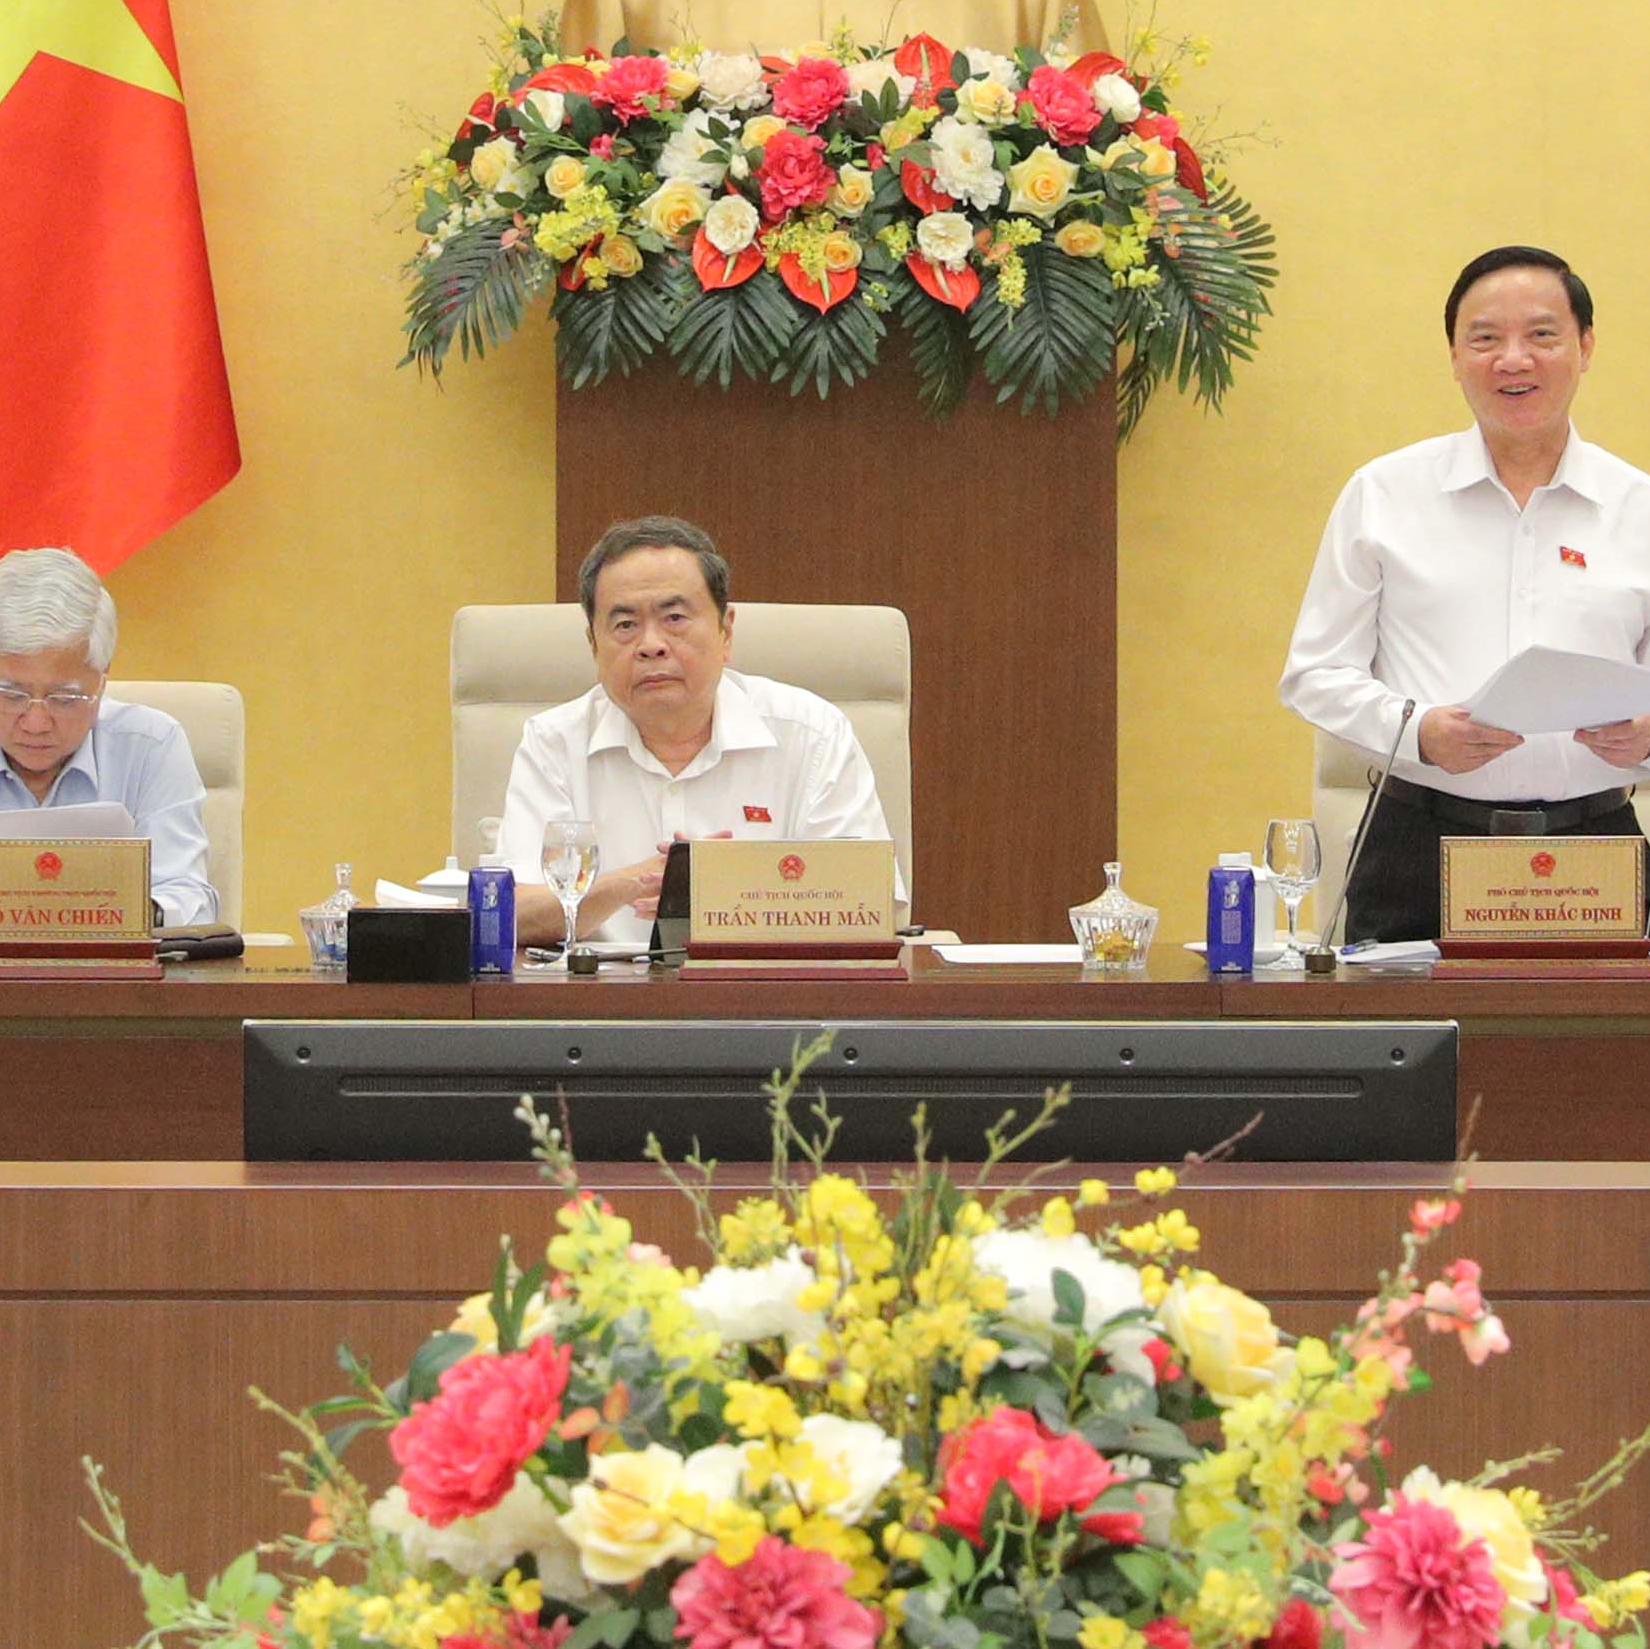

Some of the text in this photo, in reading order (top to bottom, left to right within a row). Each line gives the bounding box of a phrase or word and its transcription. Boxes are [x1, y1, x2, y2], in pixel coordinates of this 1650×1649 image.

[10, 904, 51, 926] VĂN
[58, 902, 123, 926] CHIẾN
[762, 910, 832, 927] THANH
[837, 902, 881, 927] MẪN
[1465, 901, 1622, 924] NGUYỄN KHẮC ĐỊNH
